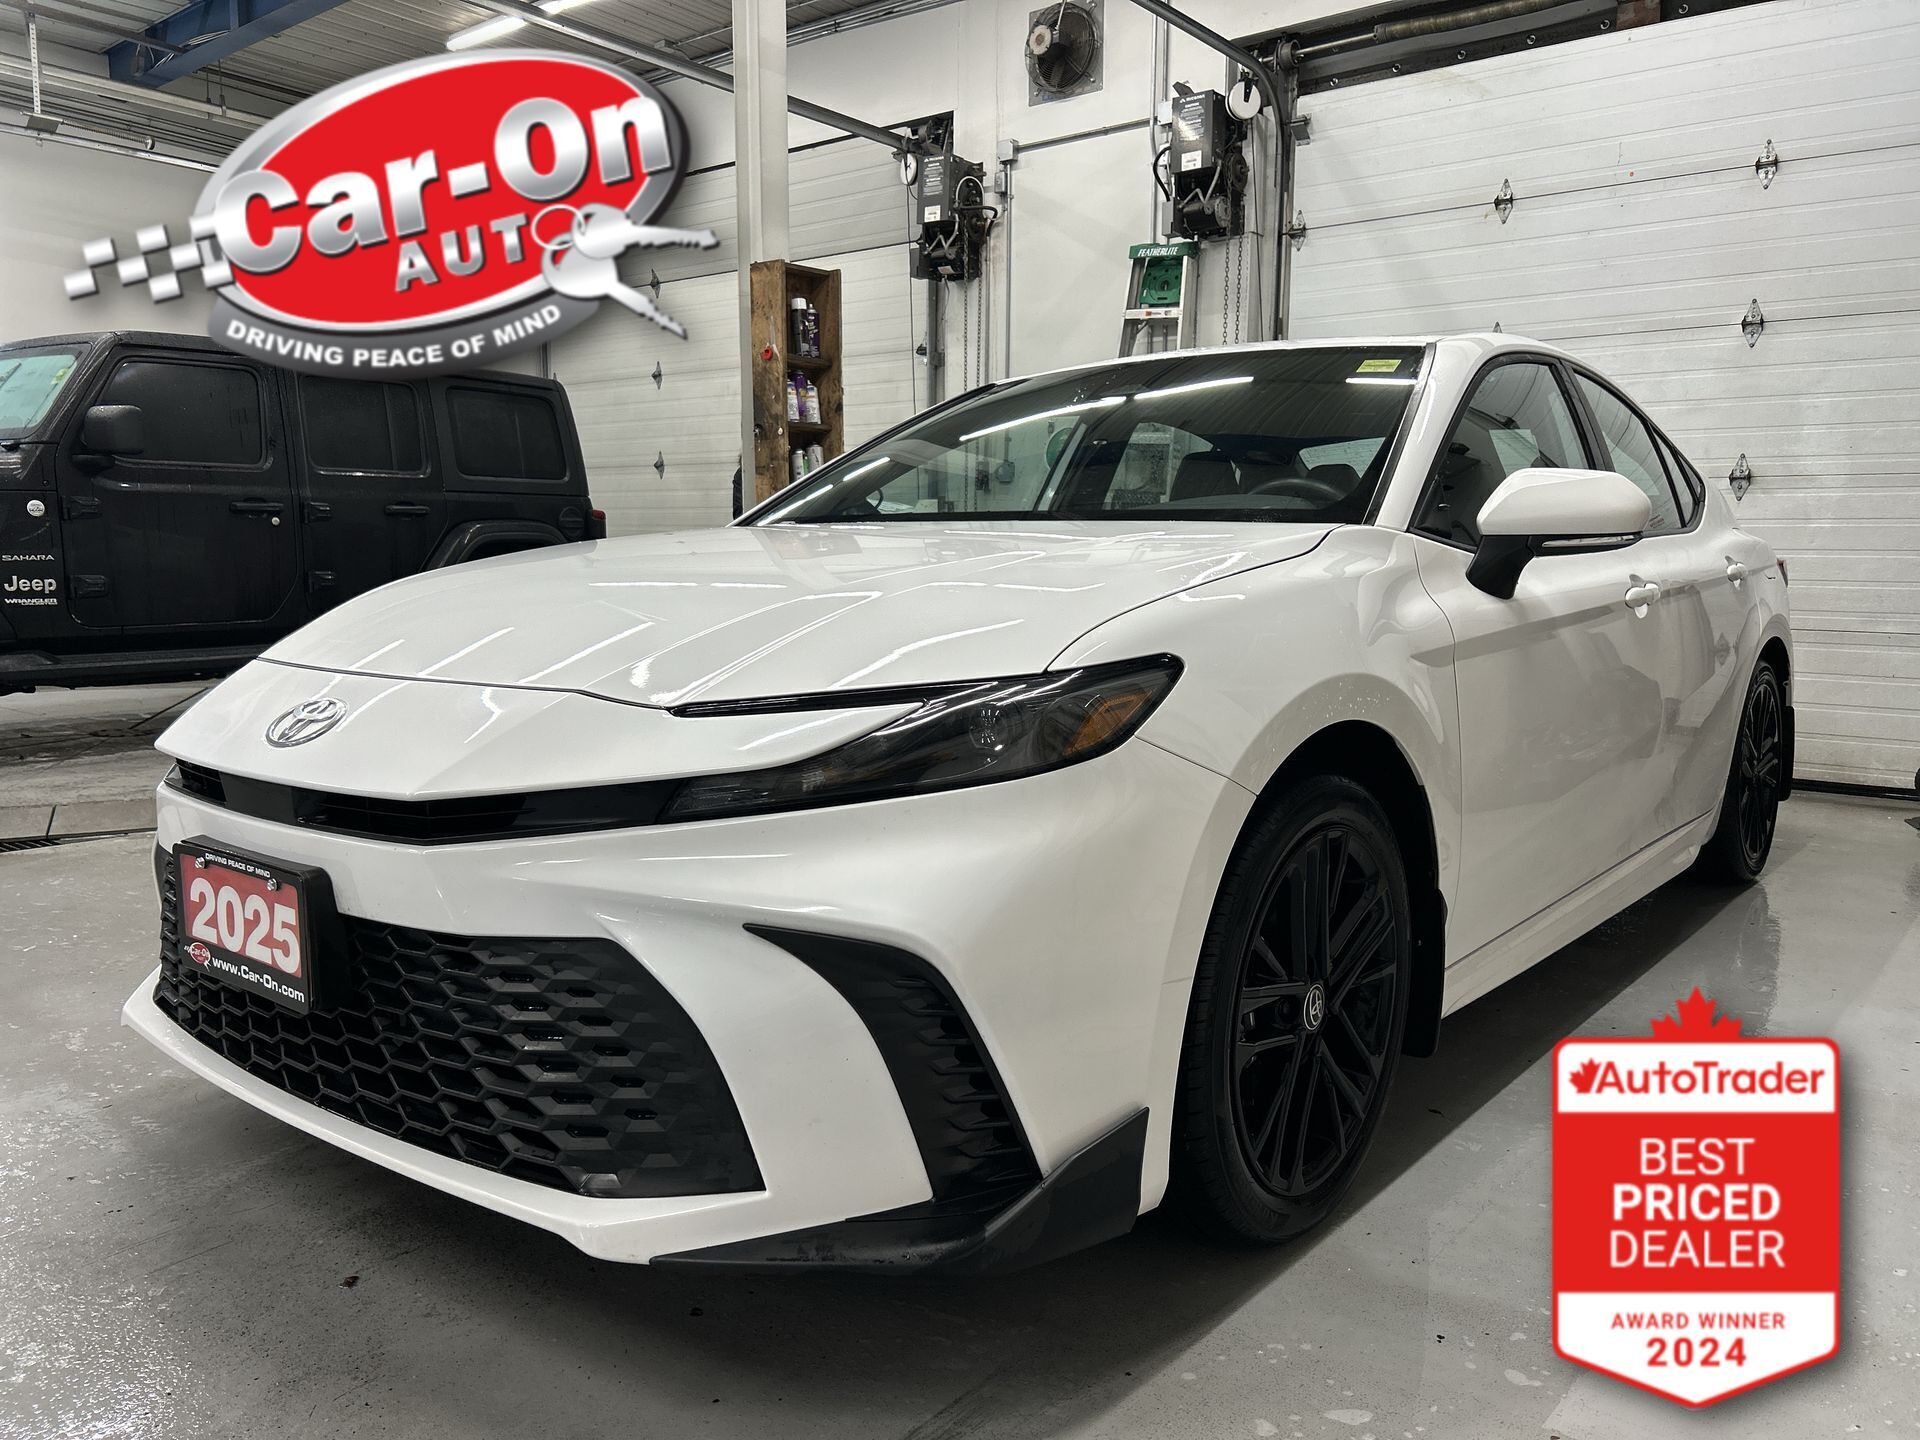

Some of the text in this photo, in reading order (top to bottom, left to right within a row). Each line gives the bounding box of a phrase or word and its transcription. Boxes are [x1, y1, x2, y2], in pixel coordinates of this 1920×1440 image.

[1137, 246, 1179, 257] FEATHERLITE
[4, 575, 57, 594] Jeep
[205, 852, 271, 878] DRIVING PEACE OF MIND
[190, 877, 301, 974] 2025
[212, 957, 305, 1003] www.Car-On.com
